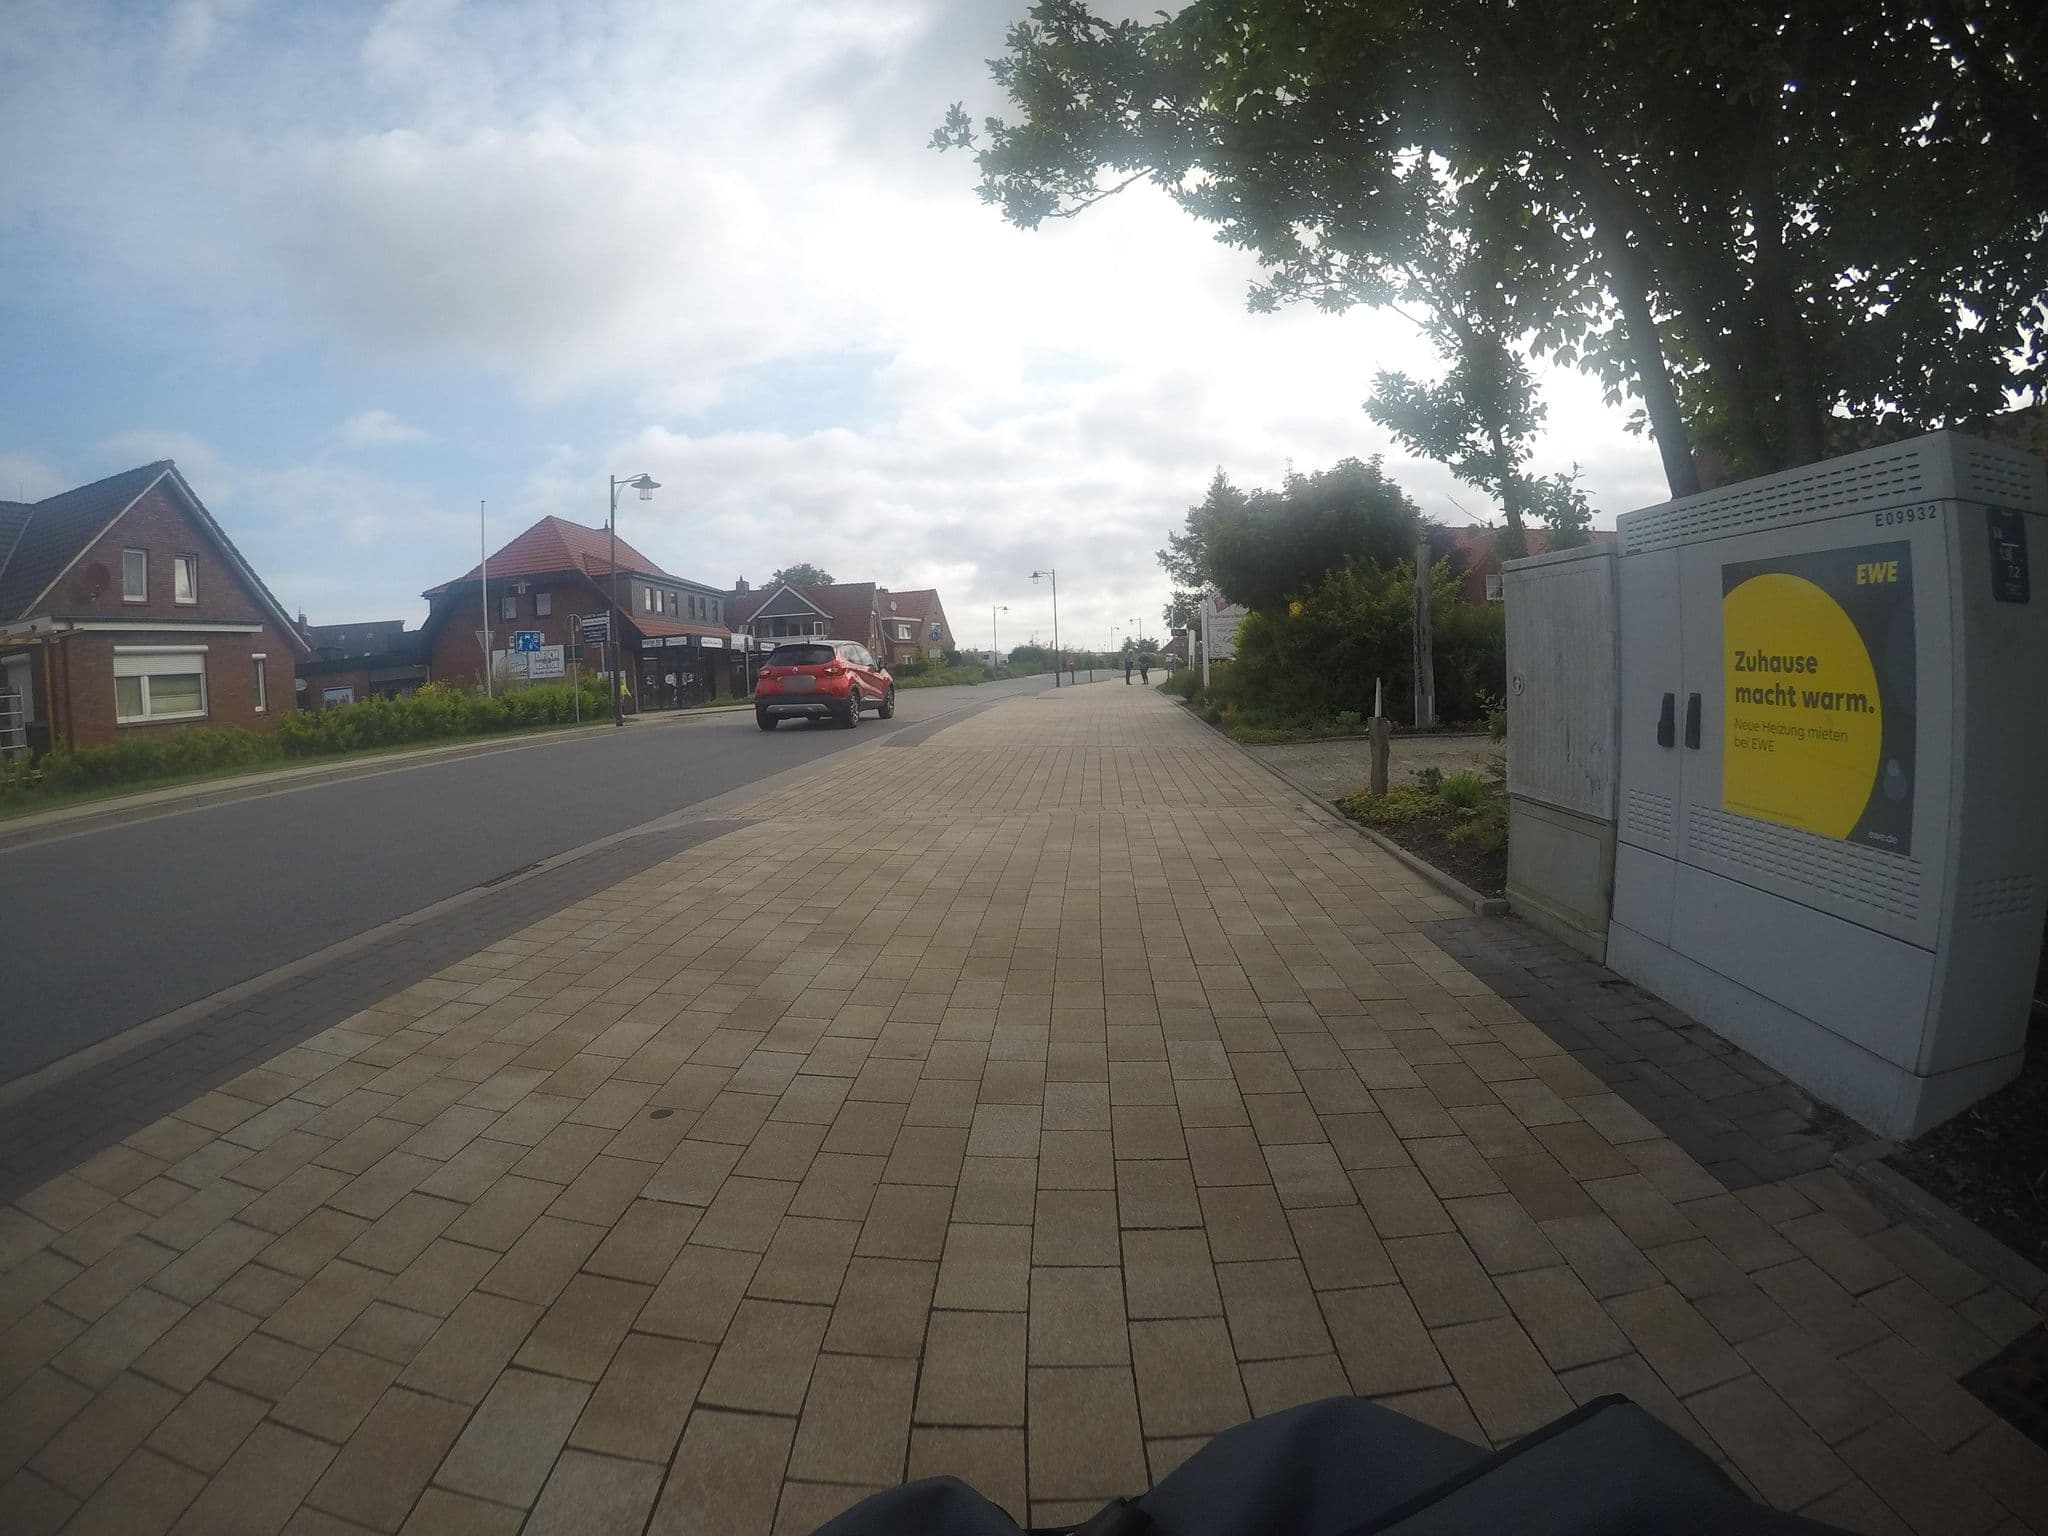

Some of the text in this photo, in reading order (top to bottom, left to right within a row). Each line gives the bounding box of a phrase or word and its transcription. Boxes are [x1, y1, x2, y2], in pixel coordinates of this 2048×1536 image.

[1875, 505, 1936, 527] E09932
[1856, 560, 1898, 584] EWE
[1734, 650, 1818, 674] Zuhause
[1735, 683, 1875, 714] macht warm.
[1734, 718, 1849, 744] Neue Heizung mieten
[1734, 735, 1775, 752] bei EWE
[1867, 831, 1898, 844] ewe.de
